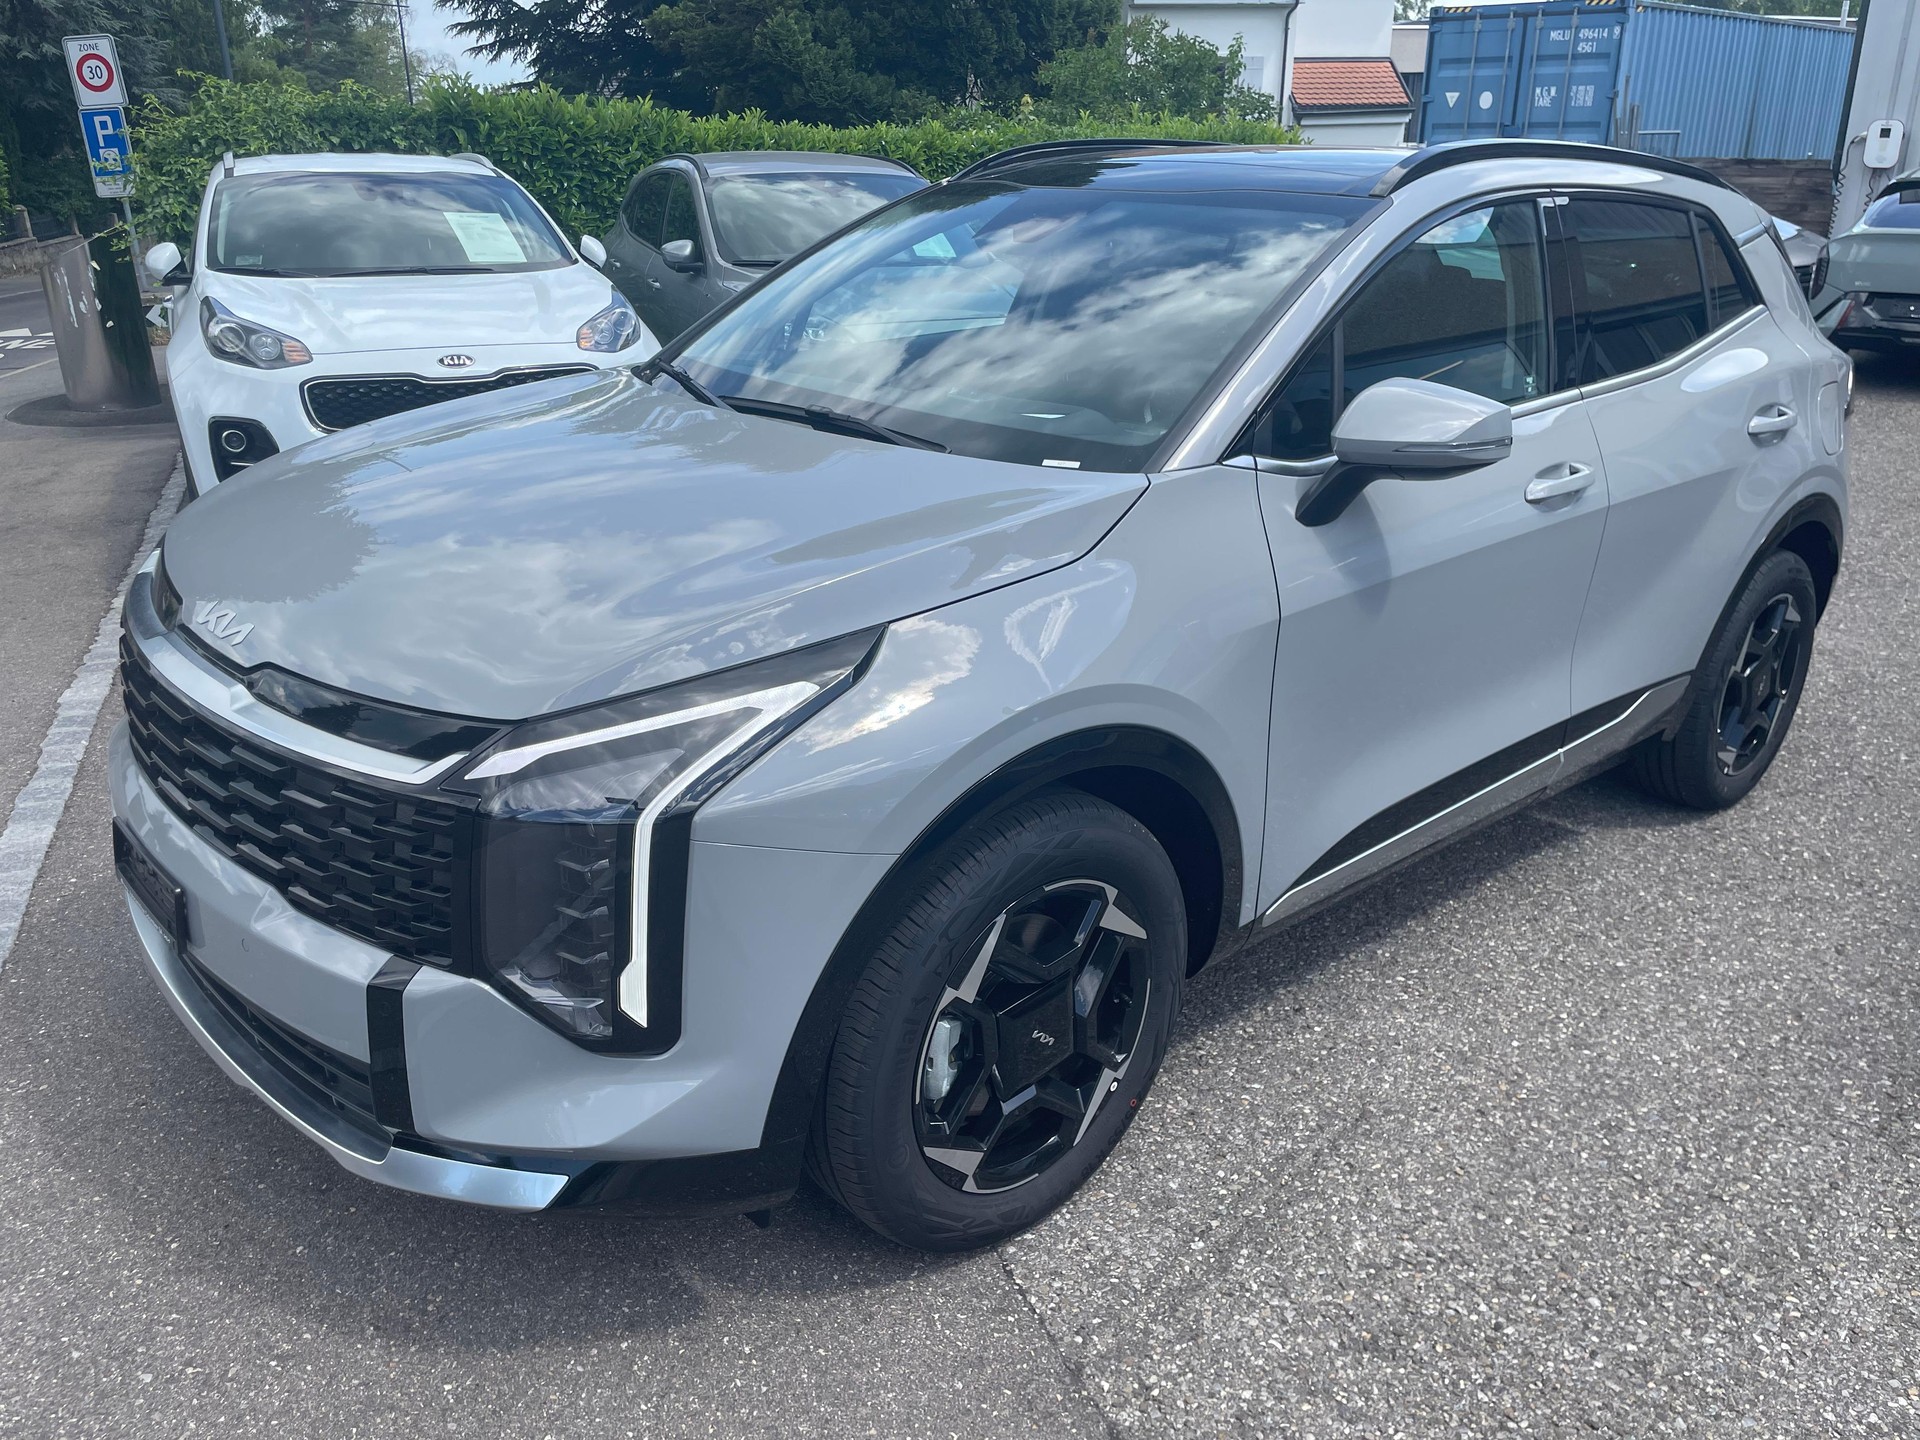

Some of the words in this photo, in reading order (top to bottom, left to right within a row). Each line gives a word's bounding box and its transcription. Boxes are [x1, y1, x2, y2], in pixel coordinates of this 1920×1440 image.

[1549, 30, 1571, 41] MGLU
[1578, 27, 1609, 40] 496414
[78, 43, 100, 52] ZONE
[1577, 41, 1597, 53] 45G1
[86, 65, 104, 80] 30
[93, 115, 114, 147] P
[442, 355, 471, 365] KIA
[196, 600, 256, 647] KIA
